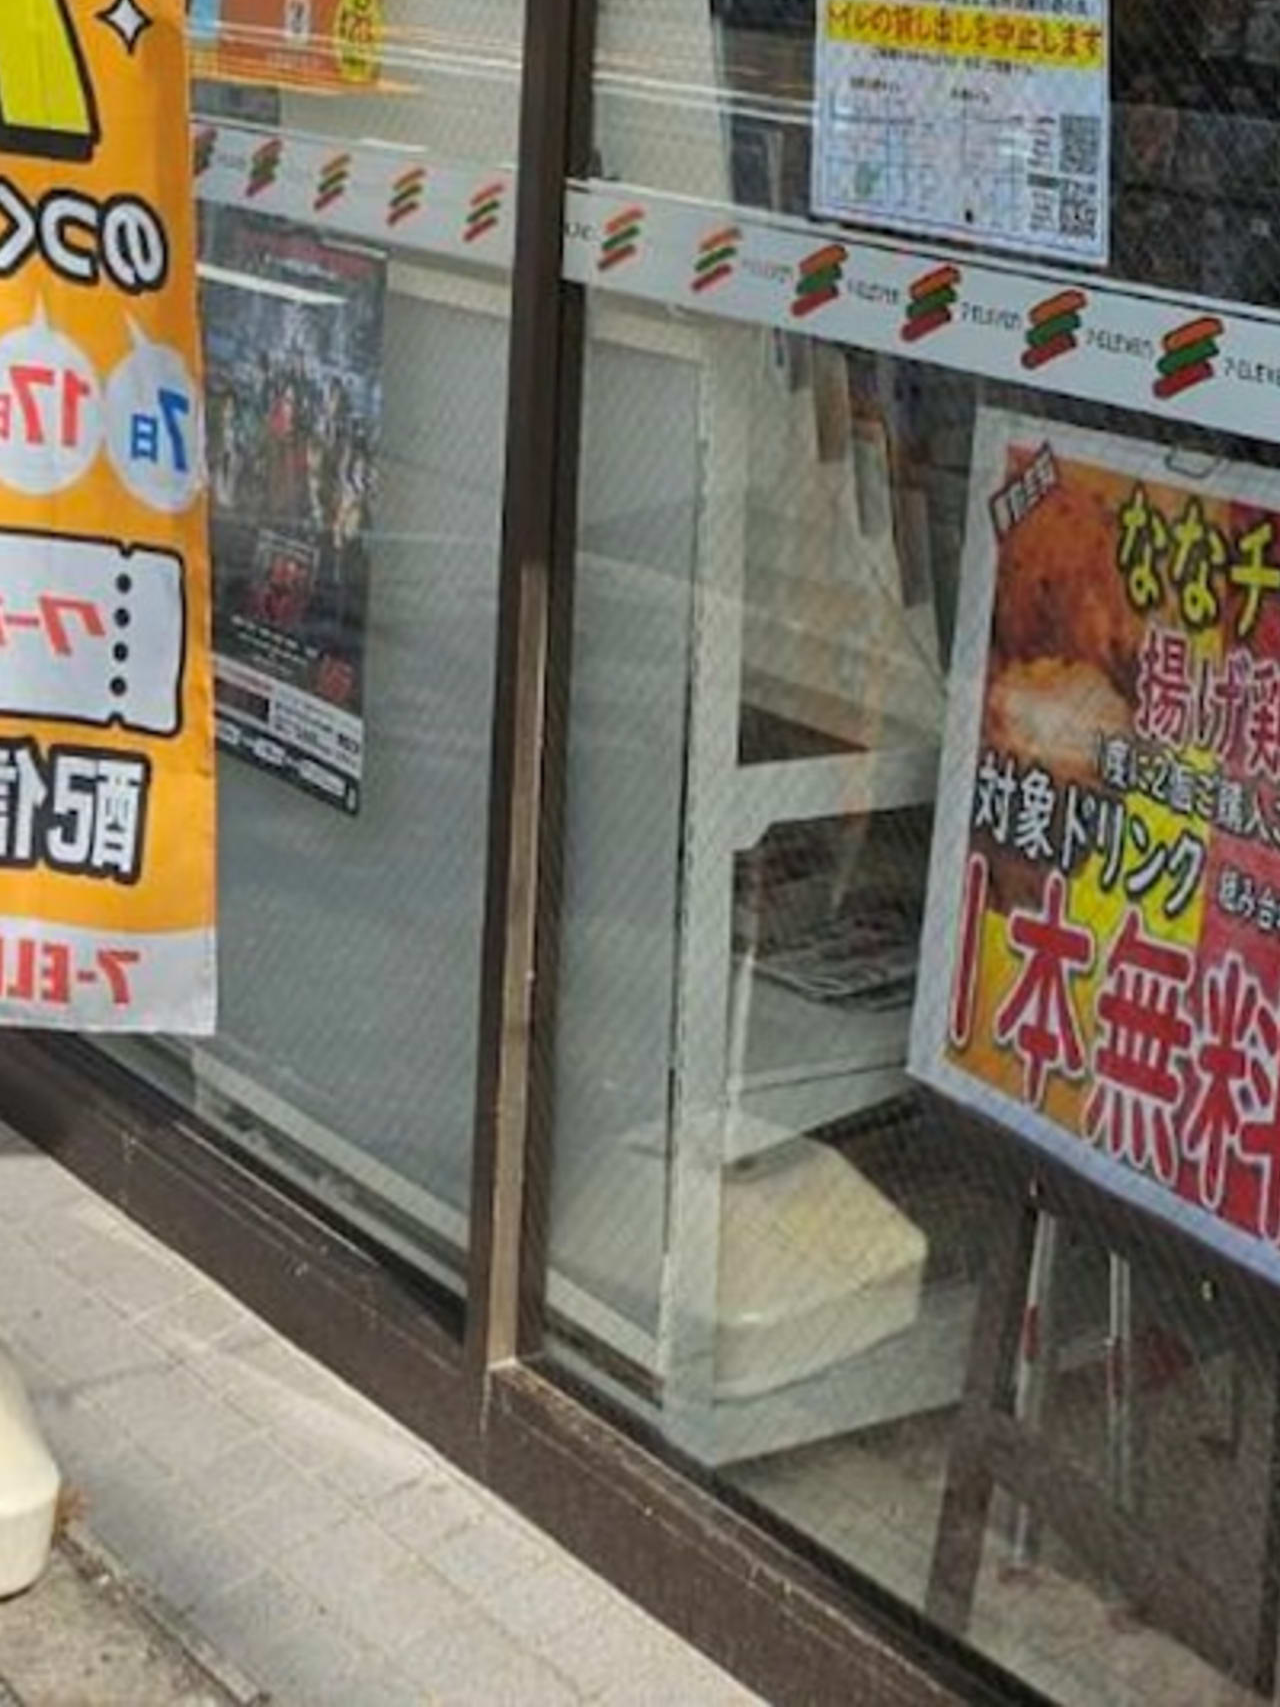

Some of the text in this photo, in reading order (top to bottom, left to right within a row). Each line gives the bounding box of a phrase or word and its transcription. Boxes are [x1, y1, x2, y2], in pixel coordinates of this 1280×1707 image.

[975, 753, 1204, 916] 対象ドリンク
